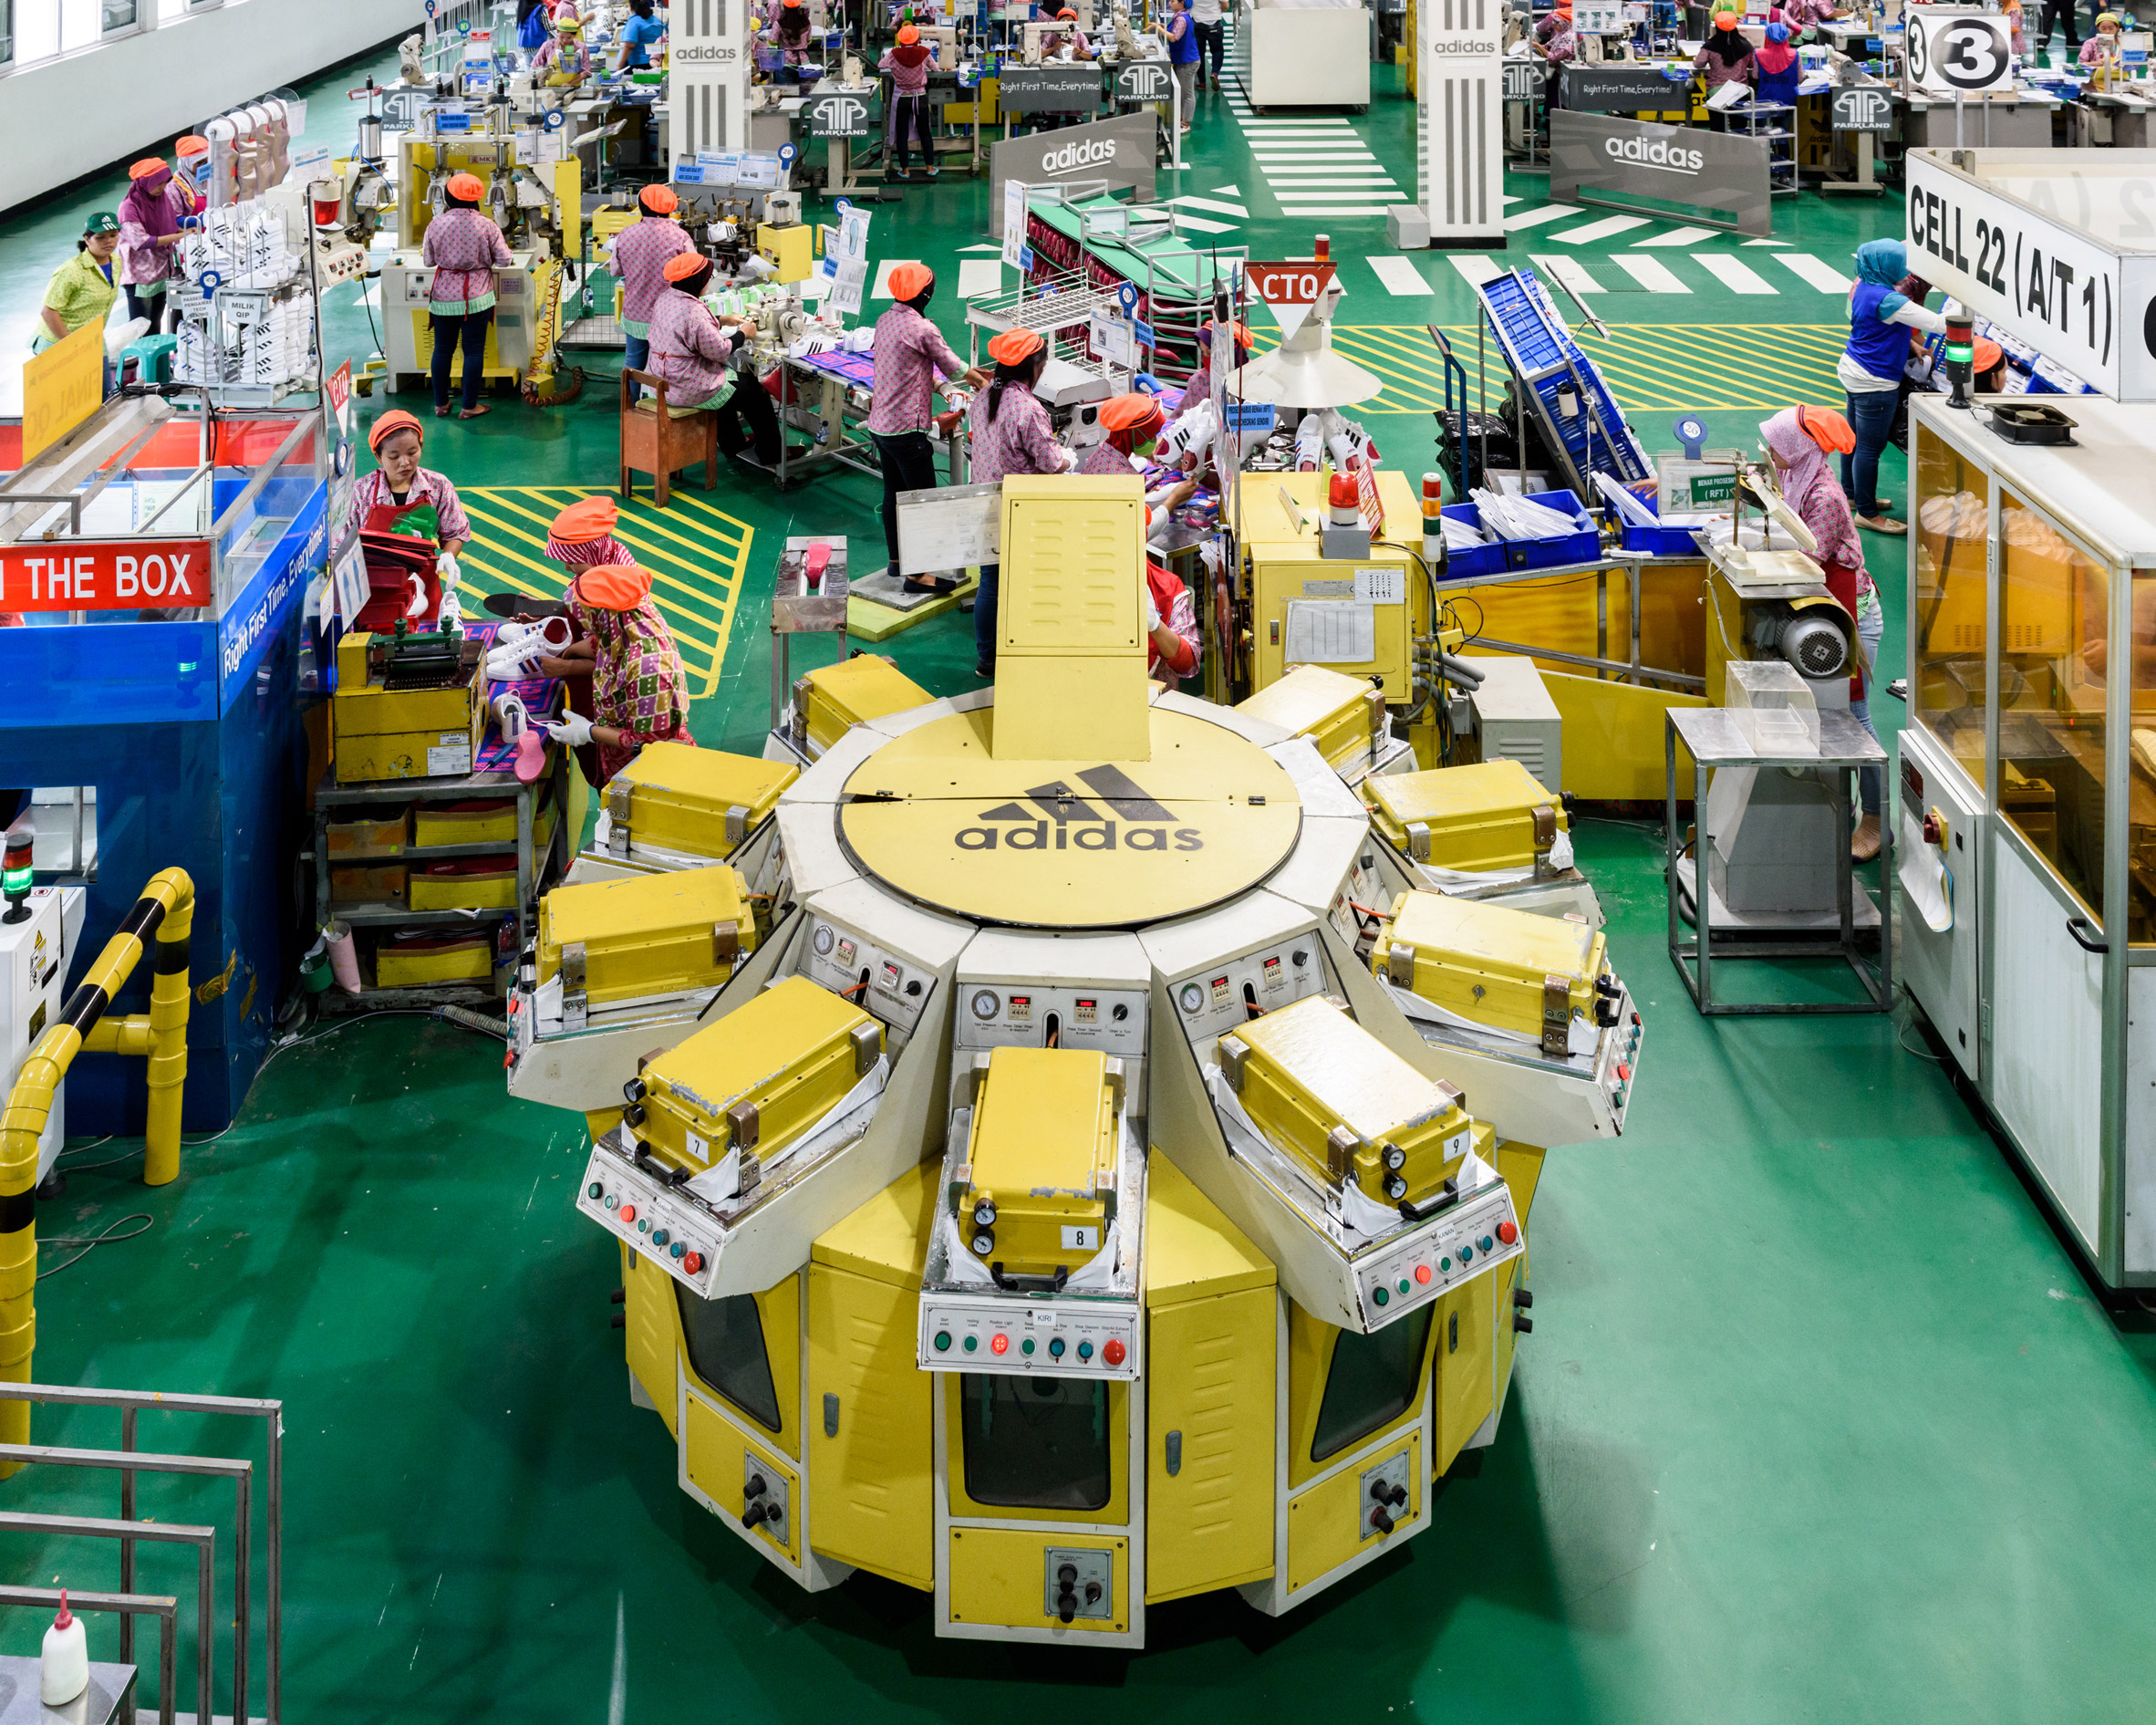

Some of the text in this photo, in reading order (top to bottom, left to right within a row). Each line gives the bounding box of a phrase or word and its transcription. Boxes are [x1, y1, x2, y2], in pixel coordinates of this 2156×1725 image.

[676, 46, 736, 59] adidas
[1435, 39, 1496, 54] adidas
[1909, 23, 1924, 76] 3
[1943, 27, 1997, 80] 3
[1000, 82, 1021, 94] Right
[1021, 81, 1040, 92] First
[1583, 84, 1601, 95] Right
[1601, 83, 1618, 94] First
[550, 114, 559, 122] 25
[1042, 137, 1116, 173] adidas
[1605, 136, 1704, 170] adidas
[1910, 184, 1969, 275] CELL
[1976, 217, 2006, 296] 22
[1262, 274, 1319, 300] CTQ
[231, 302, 255, 310] MILIK
[333, 369, 348, 407] CTQ
[1684, 423, 1698, 435] 26
[1697, 479, 1713, 487] BENAR
[24, 556, 96, 600] THE
[116, 553, 192, 598] BOX
[224, 514, 327, 680] Right First Time, Everytime!
[954, 820, 1204, 851] adidas
[694, 1139, 700, 1154] 7
[1453, 1138, 1459, 1154] 9
[1076, 1231, 1084, 1246] 8
[1437, 1226, 1455, 1241] KANAN
